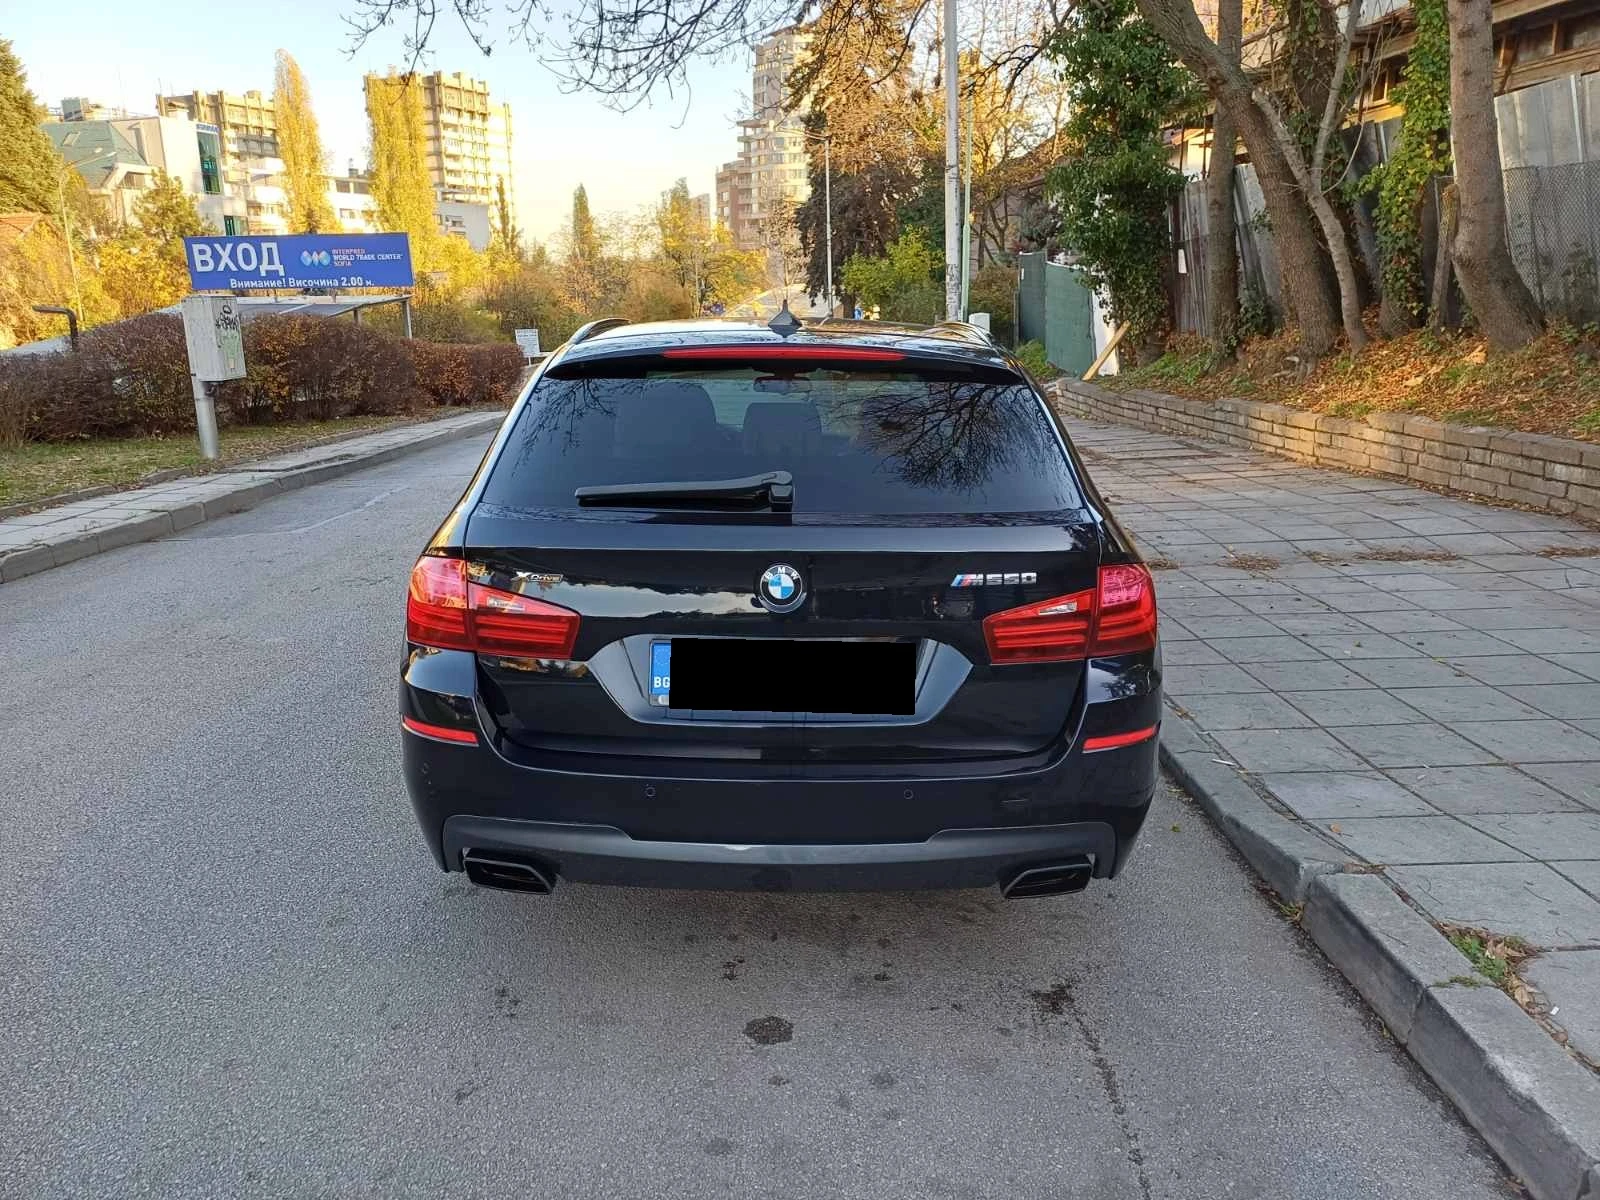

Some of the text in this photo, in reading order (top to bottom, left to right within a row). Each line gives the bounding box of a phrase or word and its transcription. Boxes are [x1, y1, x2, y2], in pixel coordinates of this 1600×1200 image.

[192, 242, 285, 277] ВХОД
[230, 278, 286, 289] Внимание!
[288, 277, 339, 288] Височина
[340, 276, 363, 287] 2.00
[653, 676, 671, 689] BG
